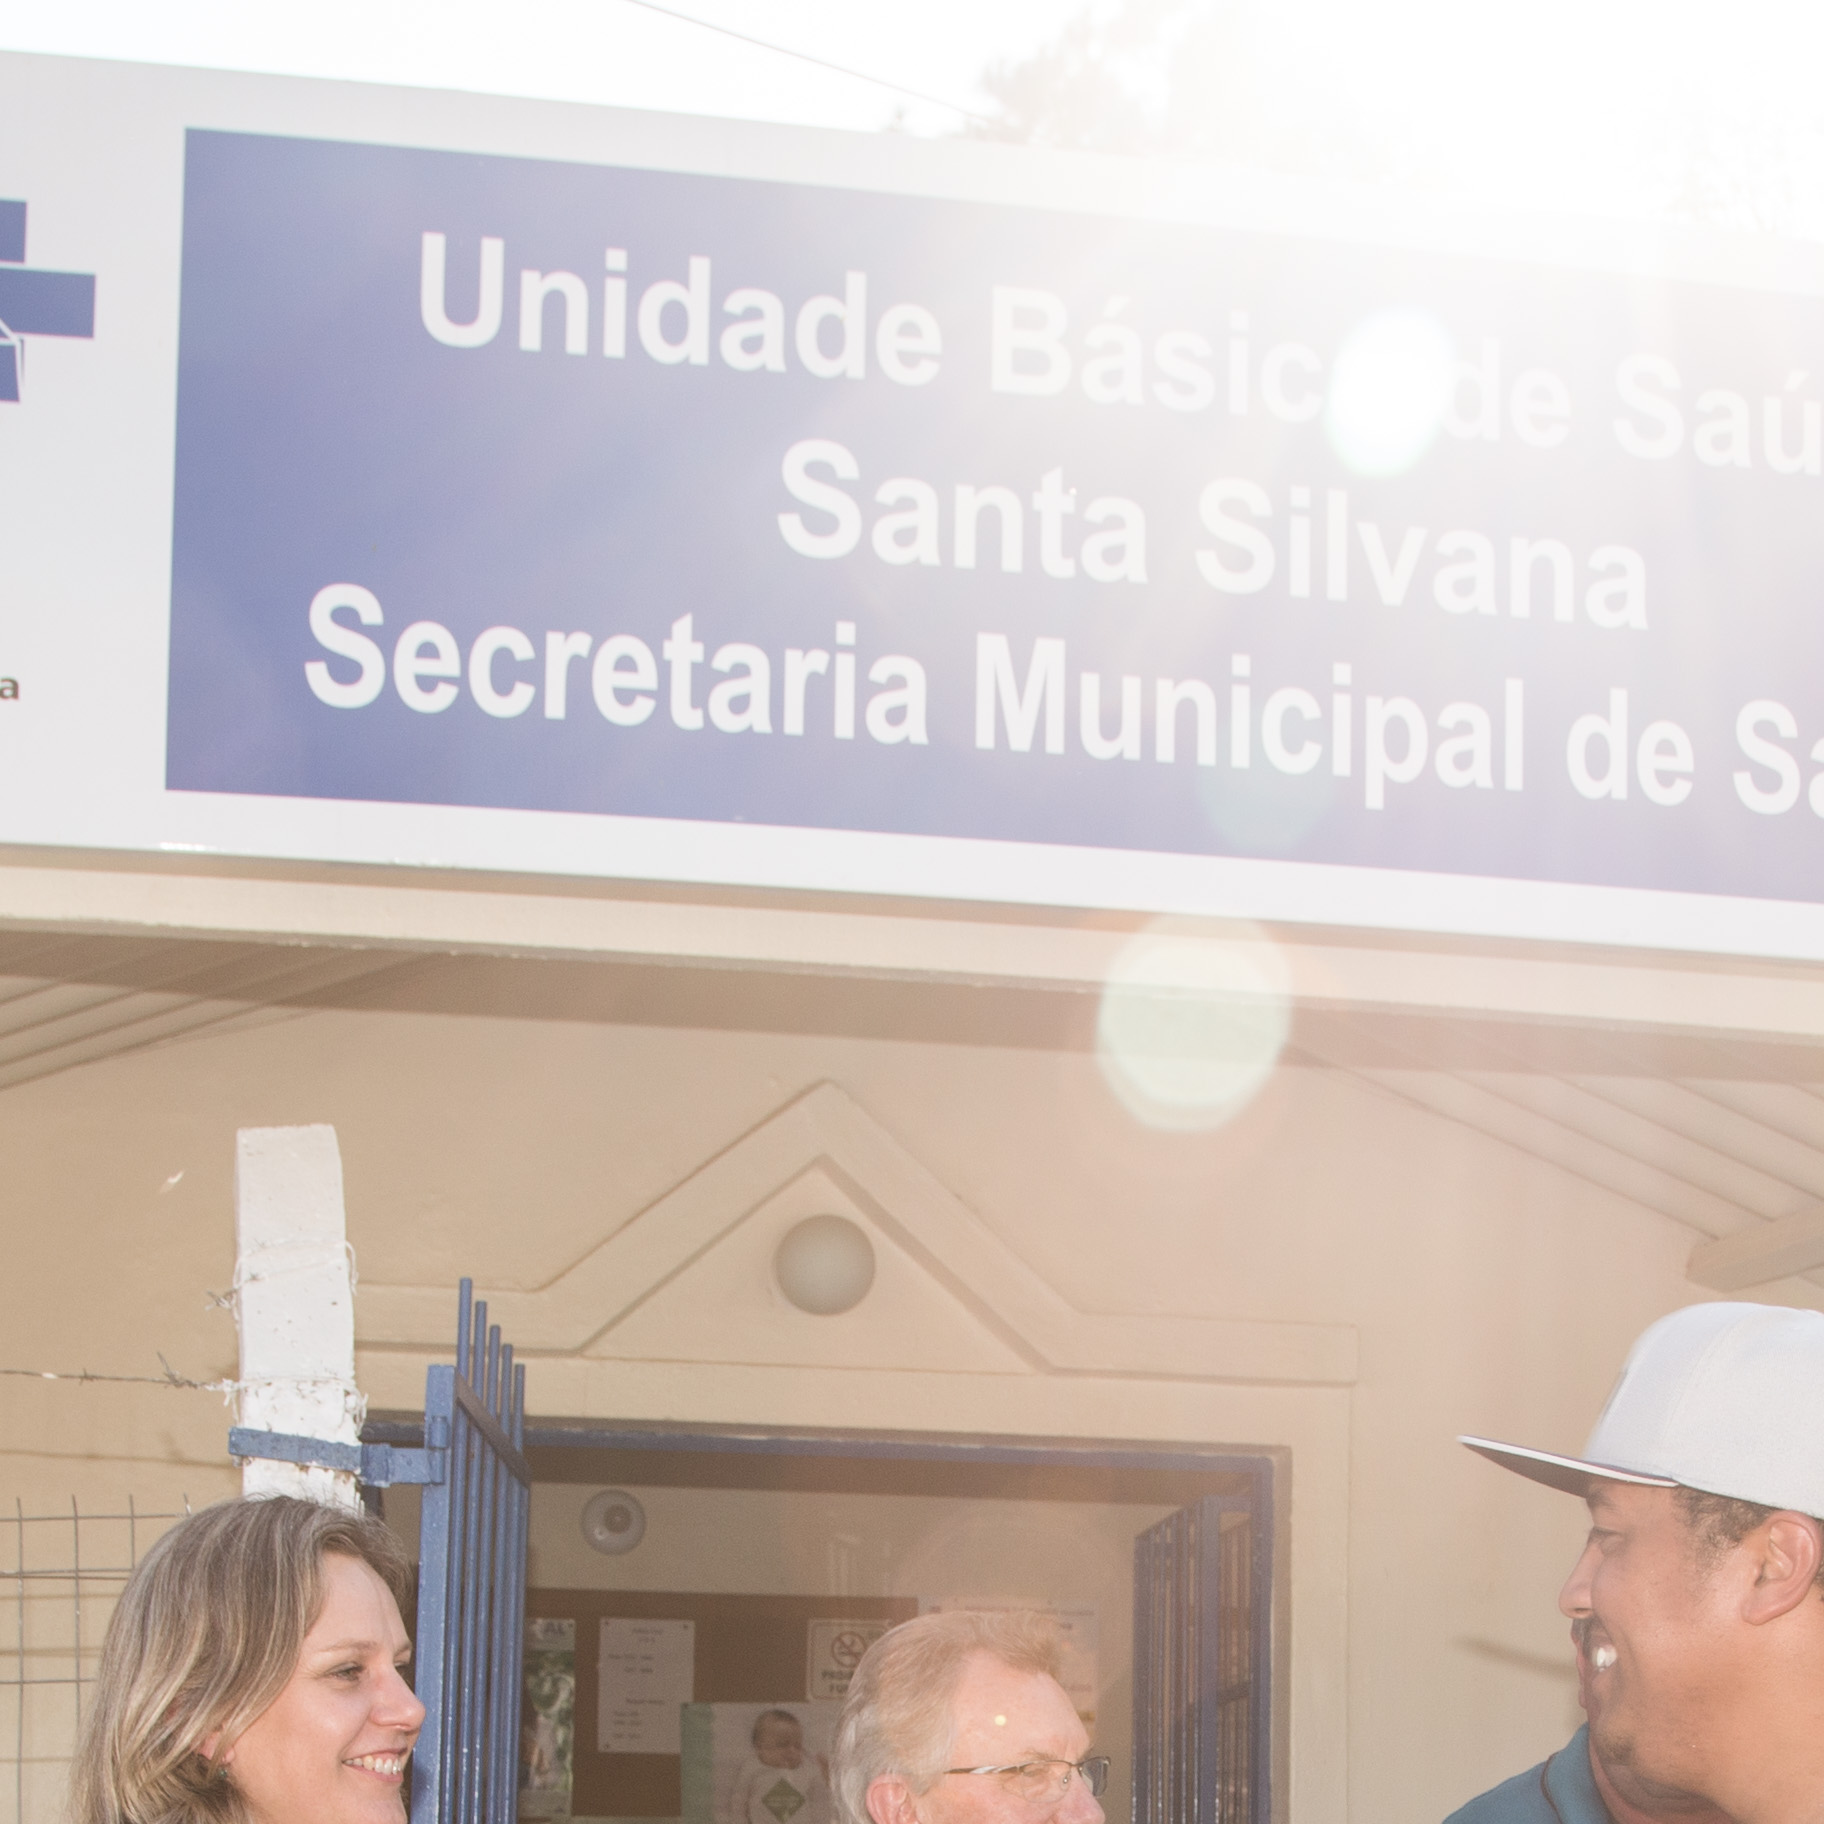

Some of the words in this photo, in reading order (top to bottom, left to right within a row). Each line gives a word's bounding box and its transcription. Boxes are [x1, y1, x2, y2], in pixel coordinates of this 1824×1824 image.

[419, 230, 943, 386] Unidade
[990, 284, 1346, 427] Básic
[1442, 338, 1572, 449] de
[776, 438, 1148, 584] Santa
[1195, 477, 1650, 631] Silvana
[304, 582, 929, 746] Secretaria
[976, 631, 1525, 810] Municipal
[1566, 686, 1695, 806] de
